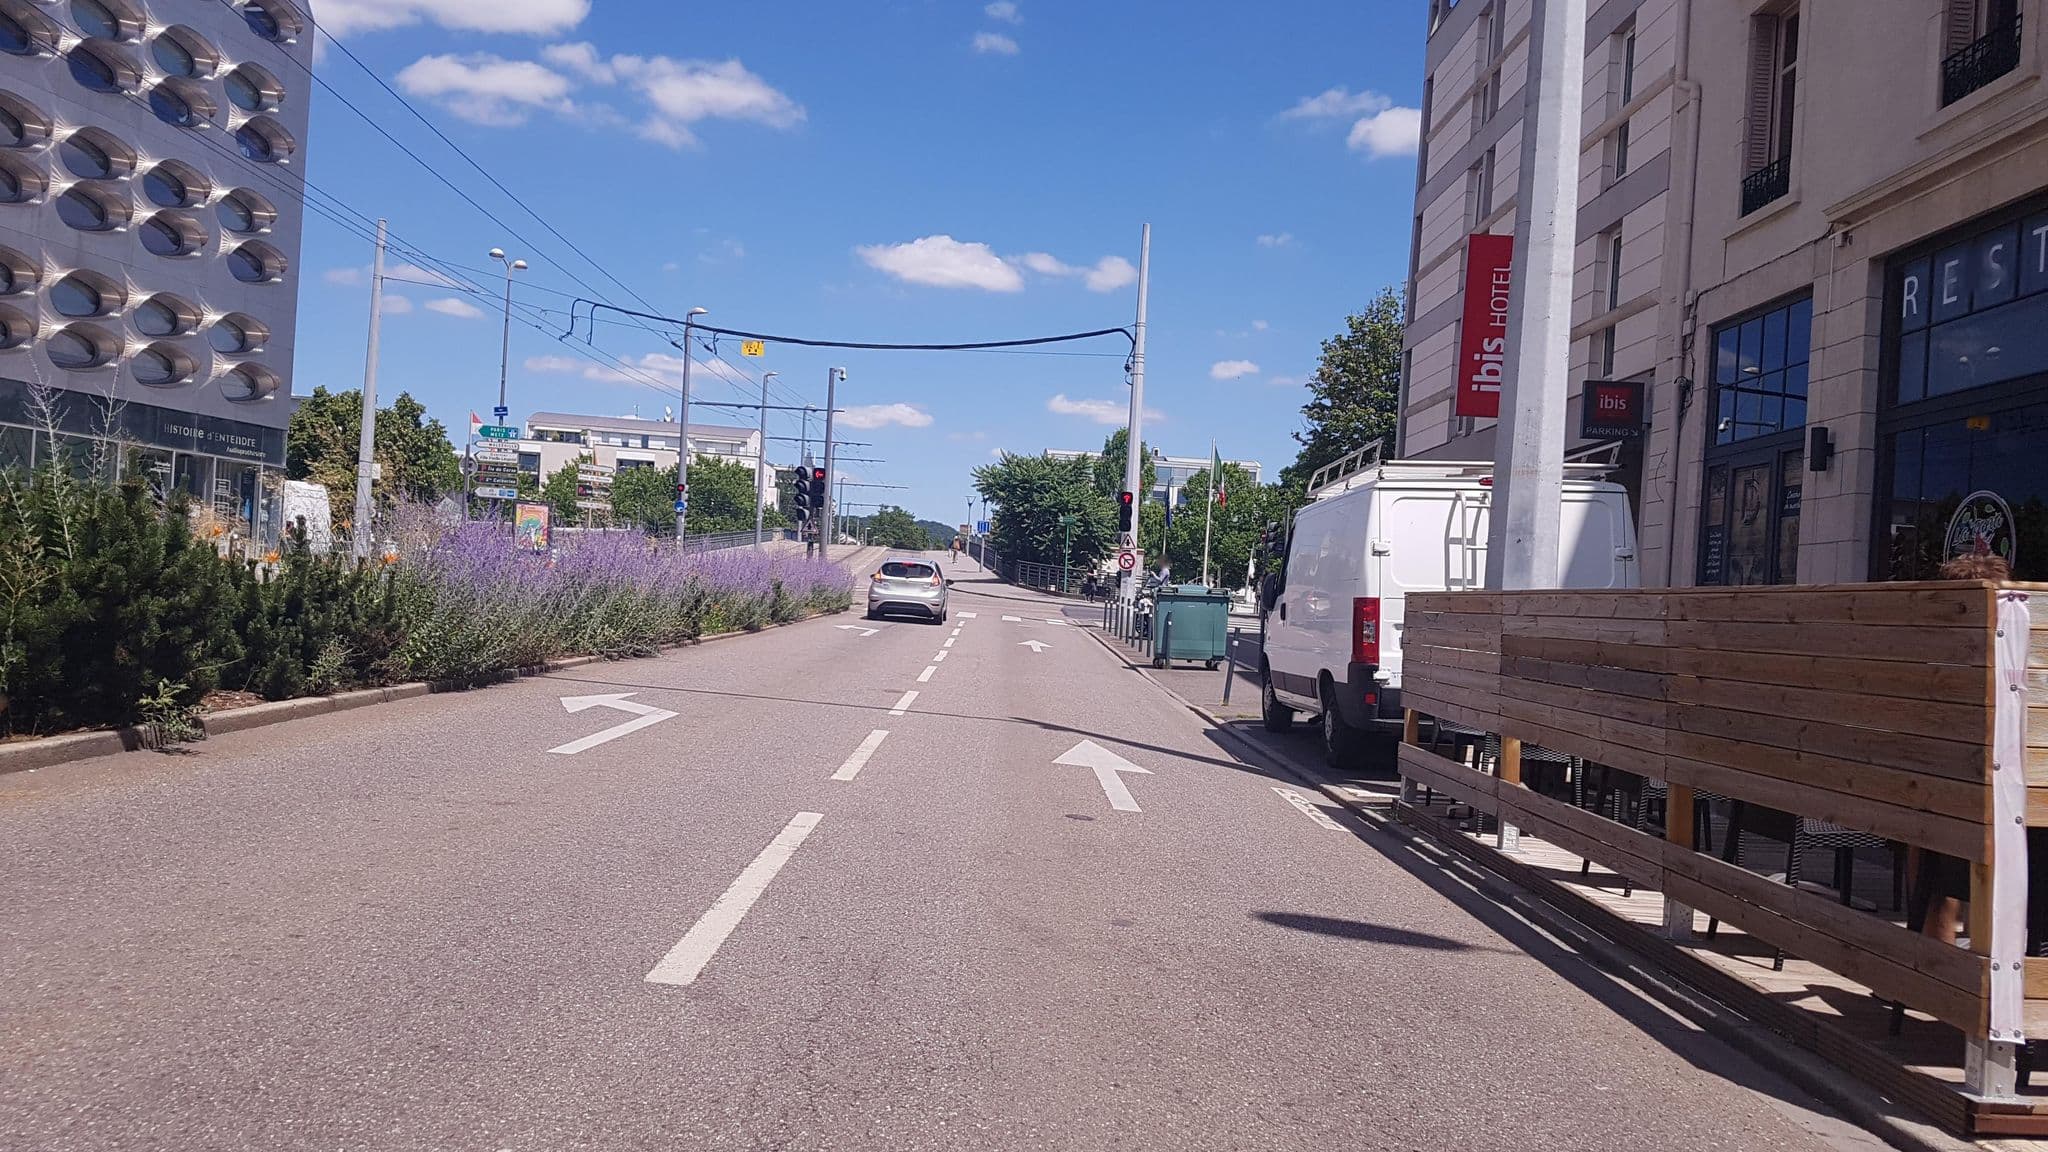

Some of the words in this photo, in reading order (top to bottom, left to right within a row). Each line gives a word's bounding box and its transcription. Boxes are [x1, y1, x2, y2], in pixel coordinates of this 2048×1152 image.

[1471, 337, 1504, 393] ibis
[1489, 261, 1512, 327] HOTEL
[1599, 395, 1626, 410] ibis
[1586, 426, 1629, 437] PARKING
